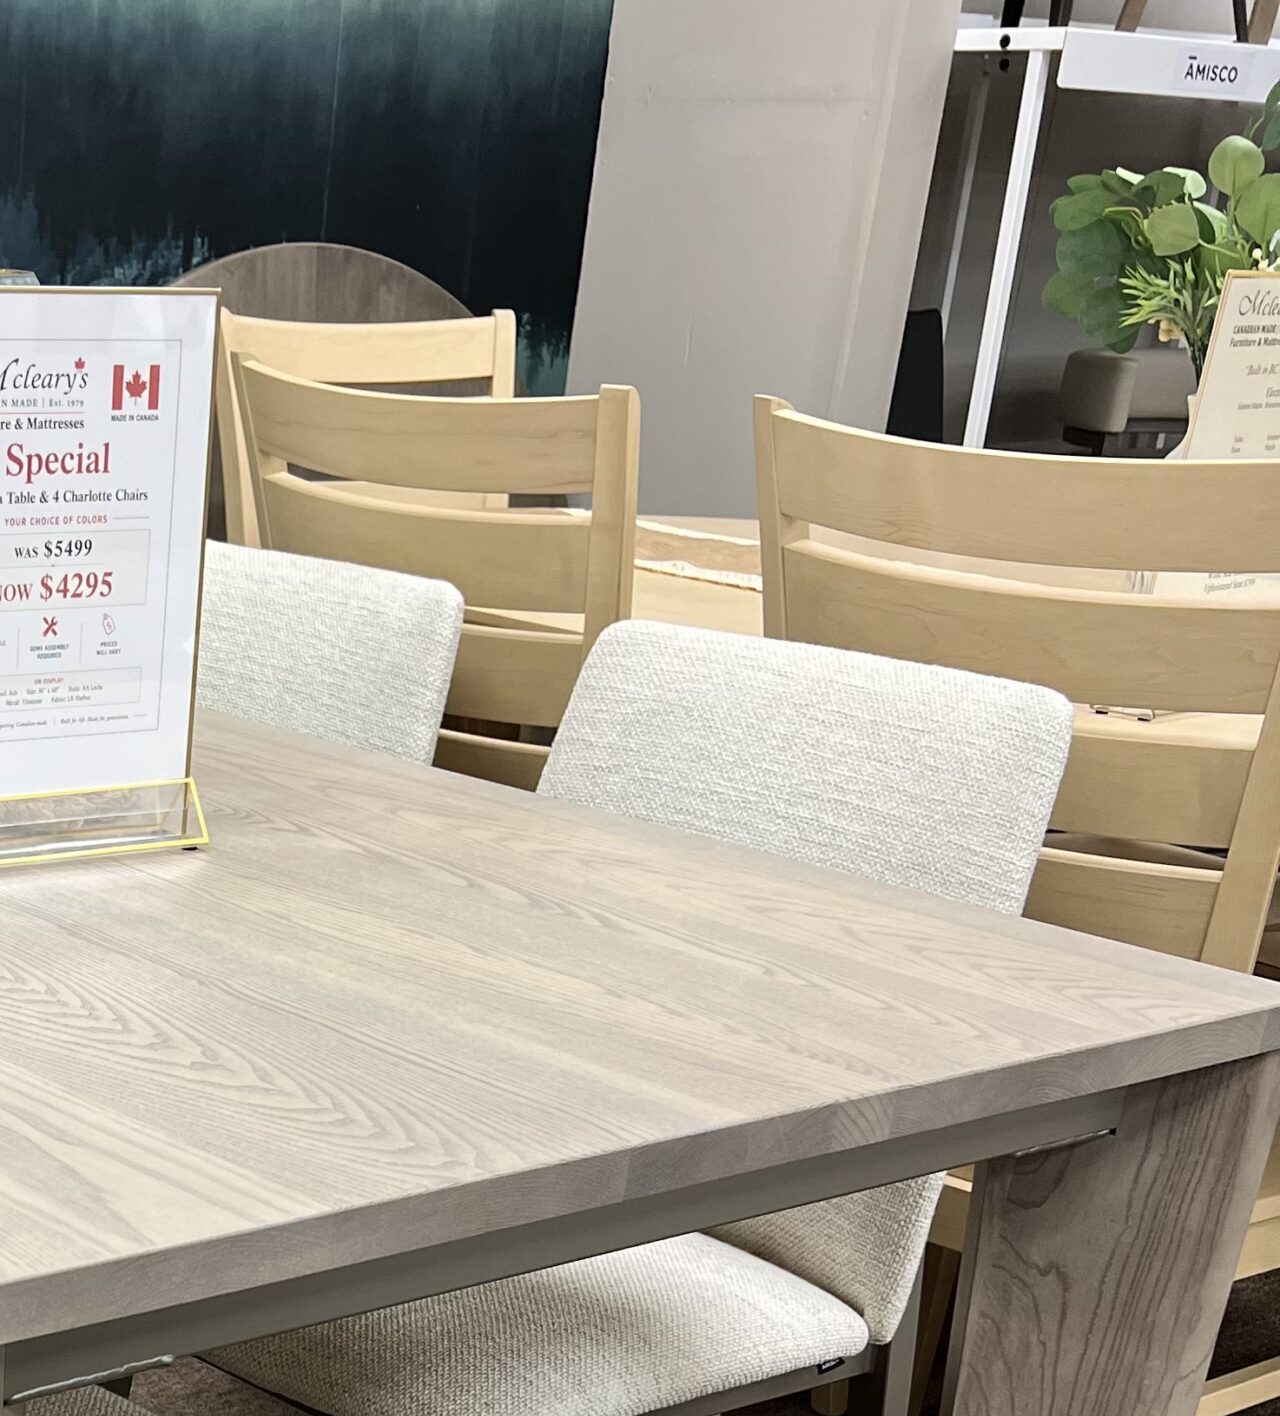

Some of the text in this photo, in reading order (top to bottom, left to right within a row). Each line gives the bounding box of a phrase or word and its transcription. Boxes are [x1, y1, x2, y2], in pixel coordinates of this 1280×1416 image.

[1239, 289, 1280, 316] Mcle
[11, 398, 38, 408] MADE
[14, 418, 23, 430] &
[26, 417, 85, 430] Mattresses
[111, 414, 127, 422] MADE
[6, 442, 110, 484] Special
[6, 491, 36, 504] Table
[39, 490, 49, 503] &
[52, 490, 60, 502] 4
[63, 489, 112, 503] Charlotte
[115, 488, 148, 502] Chairs
[5, 515, 108, 526] YOUR CHOICE OF COLORS
[14, 539, 93, 559] WAS $5499
[40, 572, 113, 602] $4295
